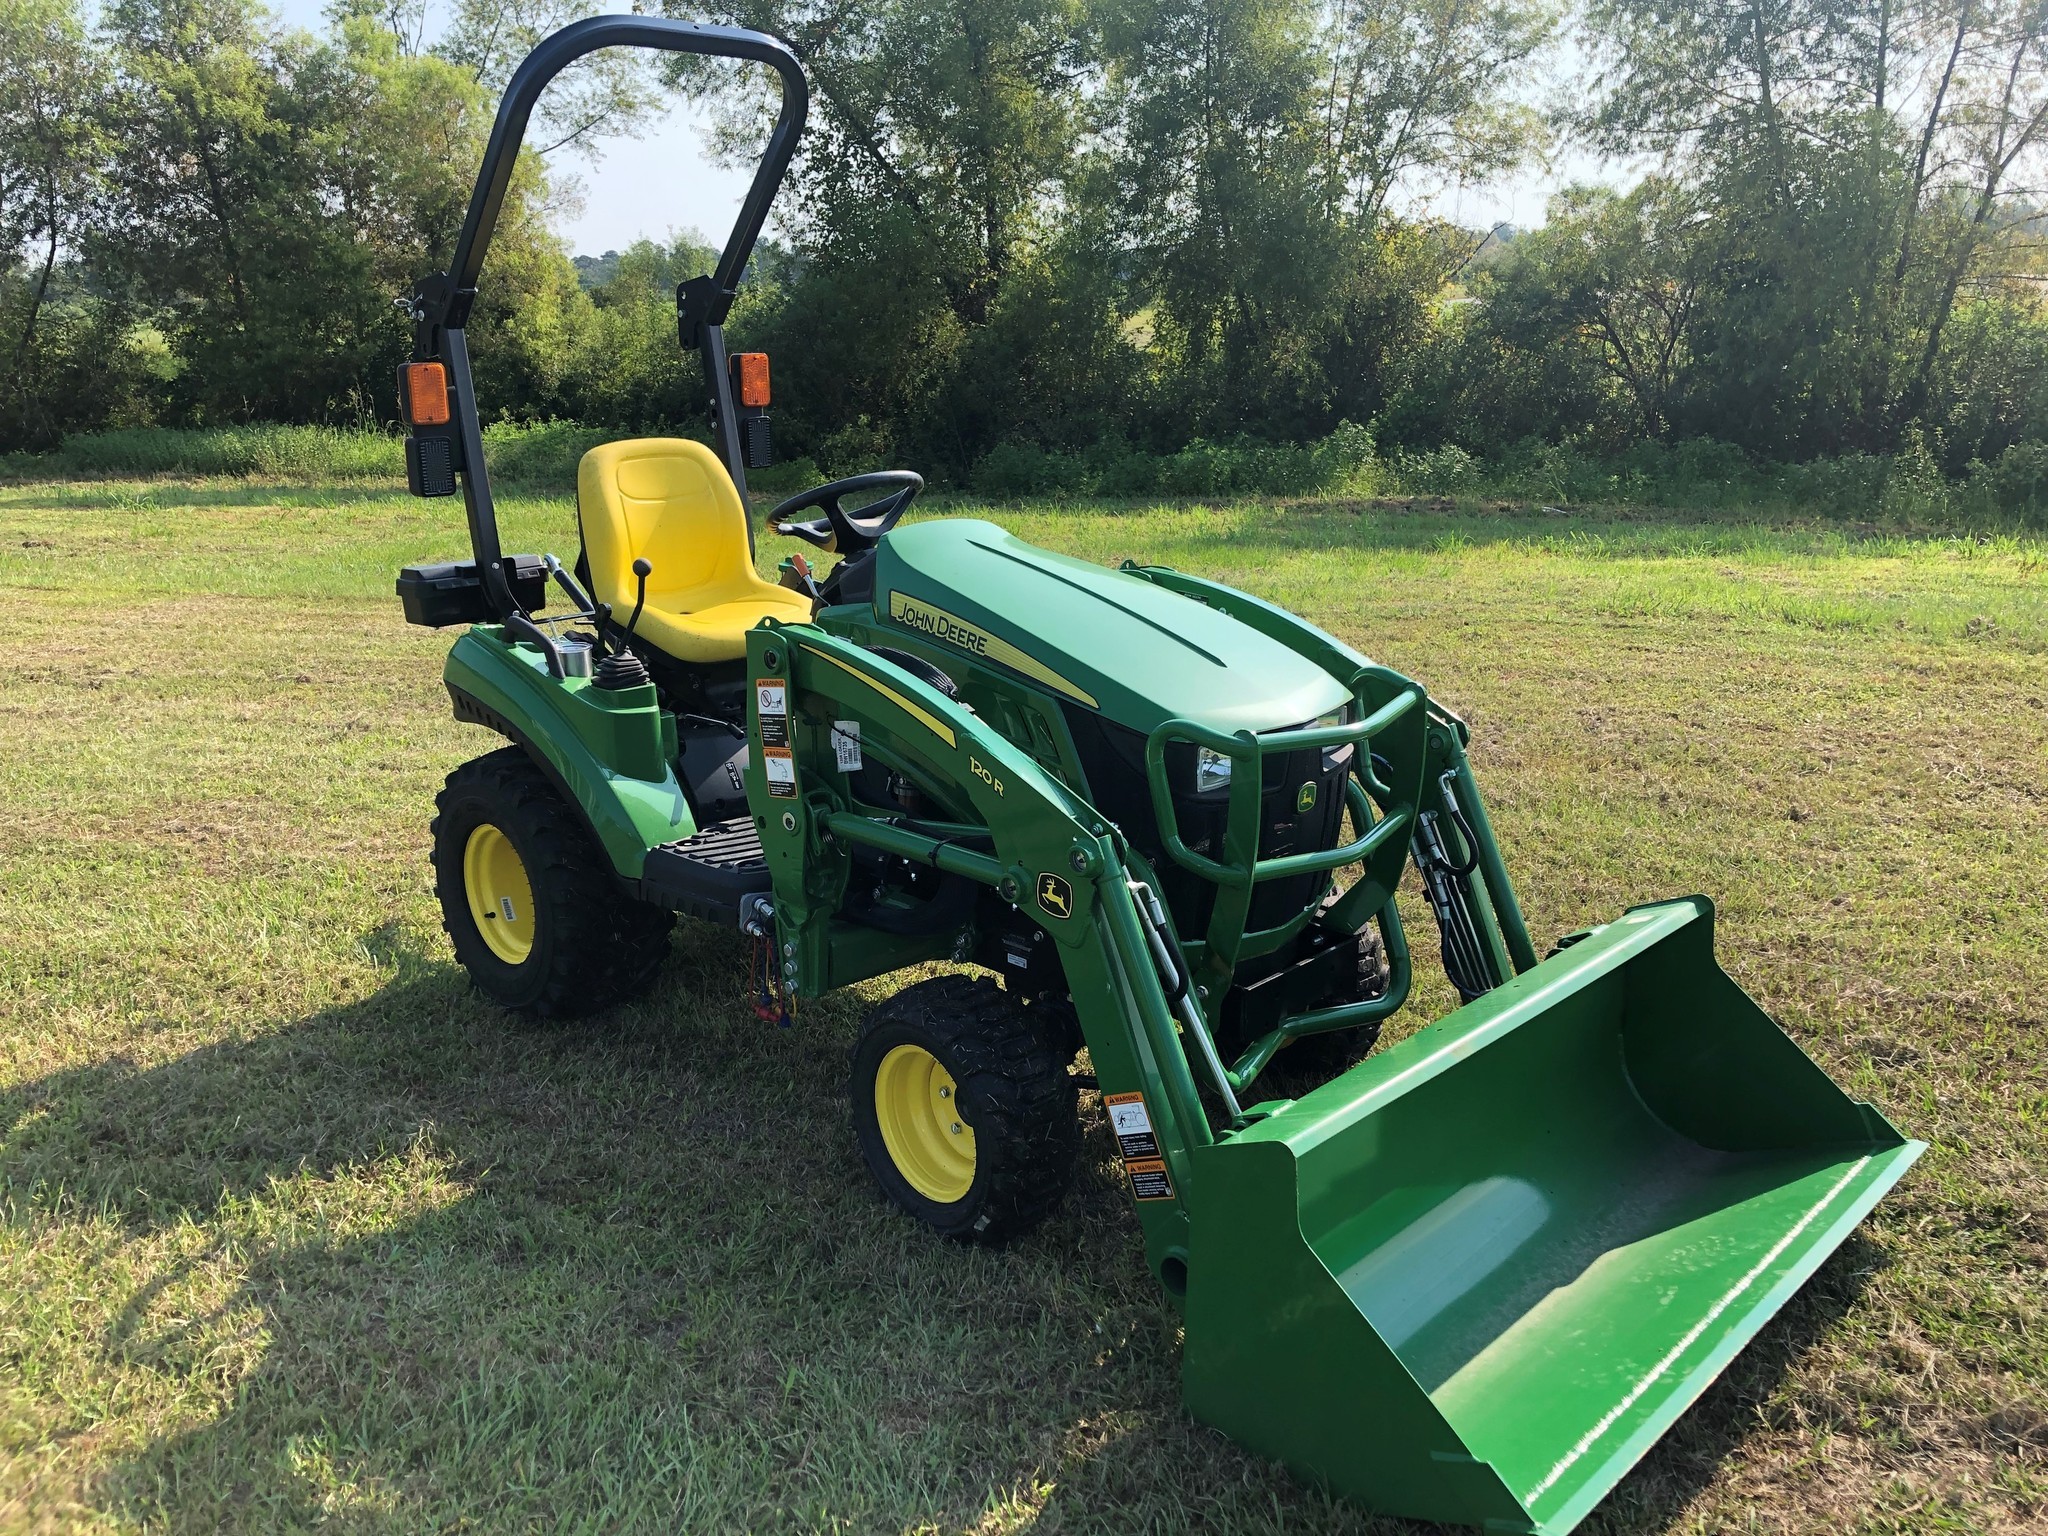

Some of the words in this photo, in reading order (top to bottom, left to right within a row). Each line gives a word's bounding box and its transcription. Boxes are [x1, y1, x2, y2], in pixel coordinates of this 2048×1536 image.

[898, 602, 936, 633] JOHN
[936, 615, 988, 655] DEERE
[768, 750, 791, 758] WARNING
[1115, 1094, 1139, 1102] WARNING
[1136, 1163, 1162, 1171] WARNING
